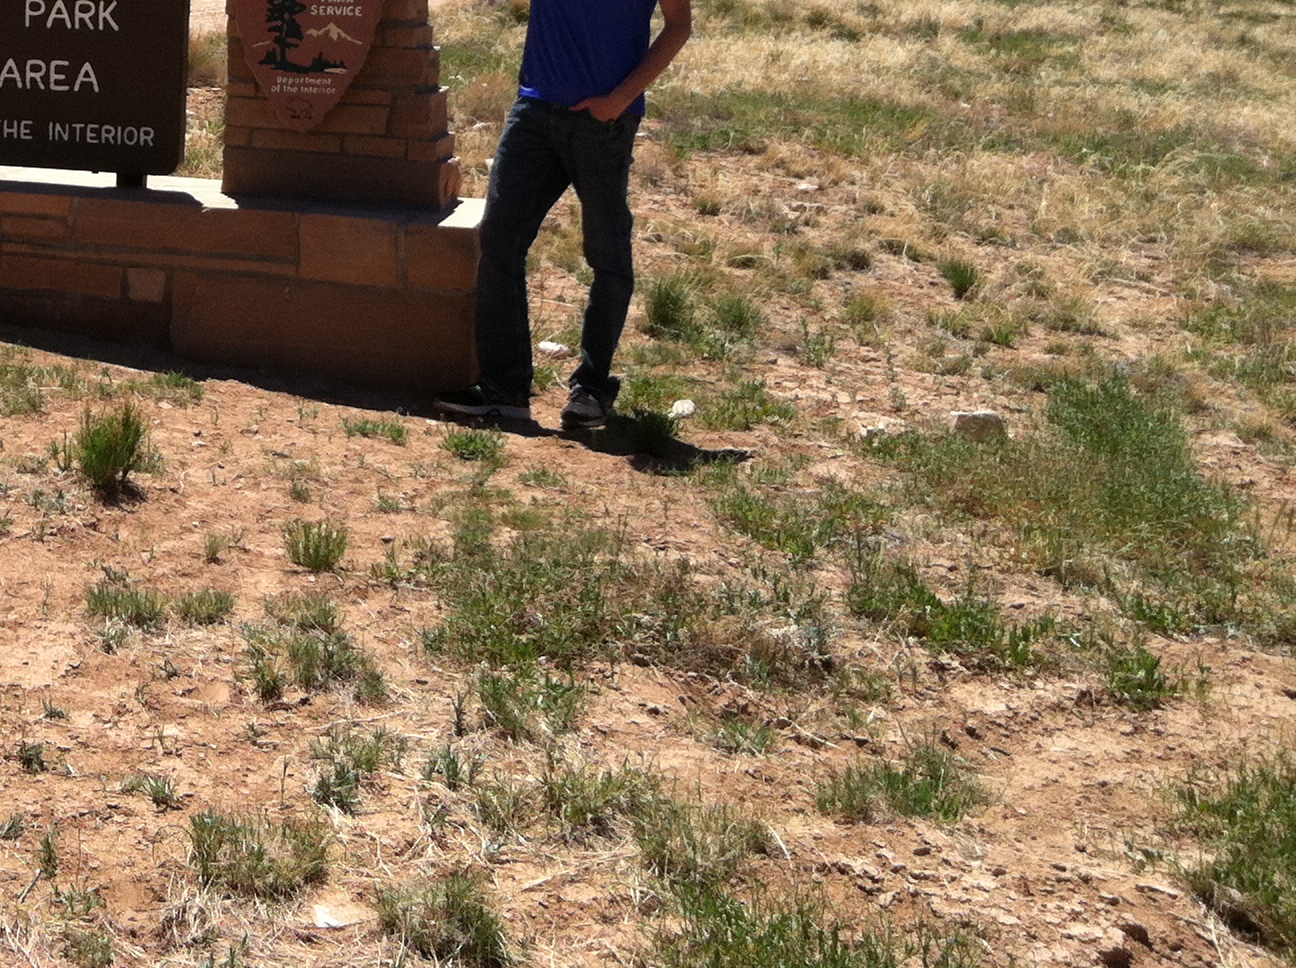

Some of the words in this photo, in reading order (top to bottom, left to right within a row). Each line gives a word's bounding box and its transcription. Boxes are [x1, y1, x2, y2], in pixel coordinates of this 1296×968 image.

[310, 5, 363, 17] SERVICE
[276, 75, 332, 86] Department
[271, 84, 280, 93] of
[283, 84, 298, 93] the
[48, 121, 155, 147] INTERIOR
